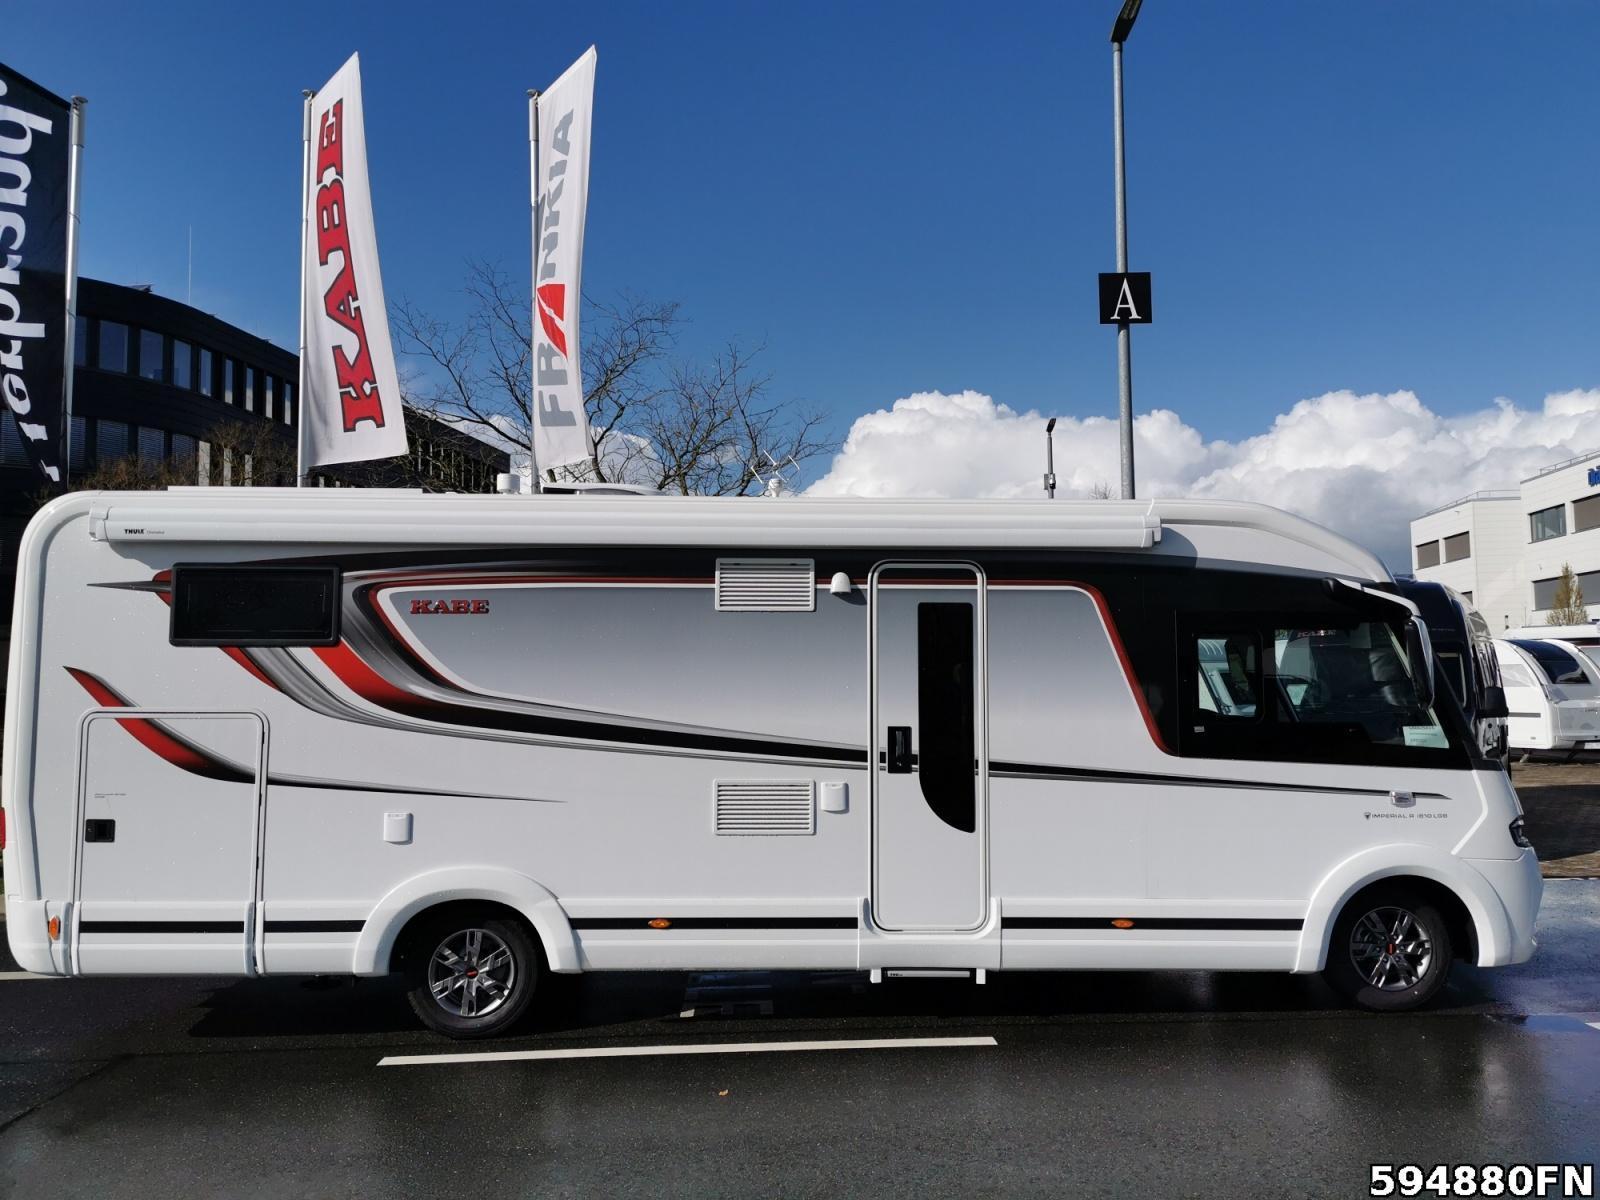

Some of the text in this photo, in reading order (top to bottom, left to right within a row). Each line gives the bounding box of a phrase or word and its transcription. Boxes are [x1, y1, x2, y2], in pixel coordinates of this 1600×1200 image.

[317, 97, 386, 433] KABE
[536, 108, 577, 427] FRANKIA
[1110, 277, 1142, 319] A
[410, 599, 490, 614] KABE
